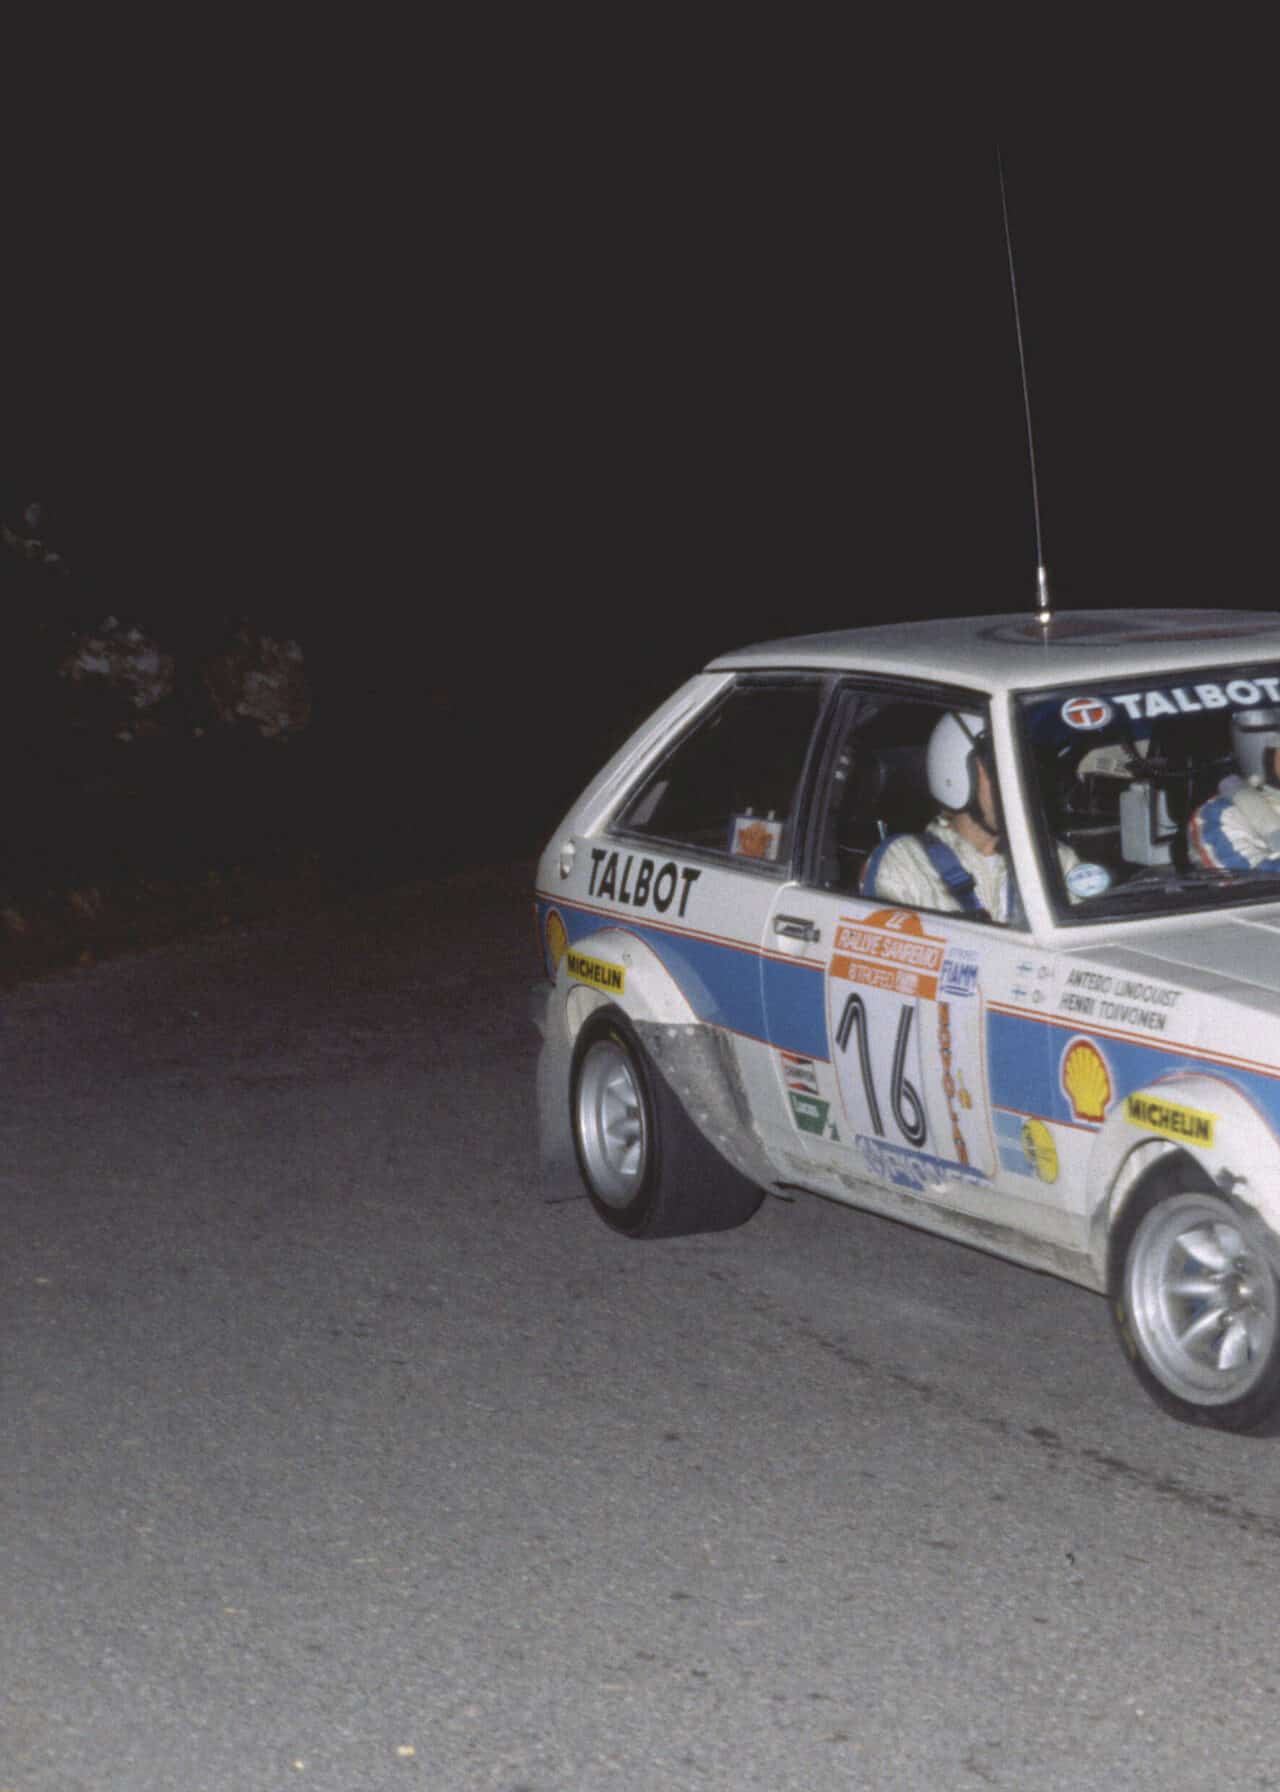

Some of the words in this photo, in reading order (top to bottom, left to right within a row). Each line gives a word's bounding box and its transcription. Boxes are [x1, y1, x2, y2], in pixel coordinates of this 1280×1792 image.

[588, 848, 702, 918] TALBOT
[567, 952, 623, 989] MICHELIN
[835, 992, 927, 1148] 16
[1127, 1096, 1210, 1141] MICHELIN
